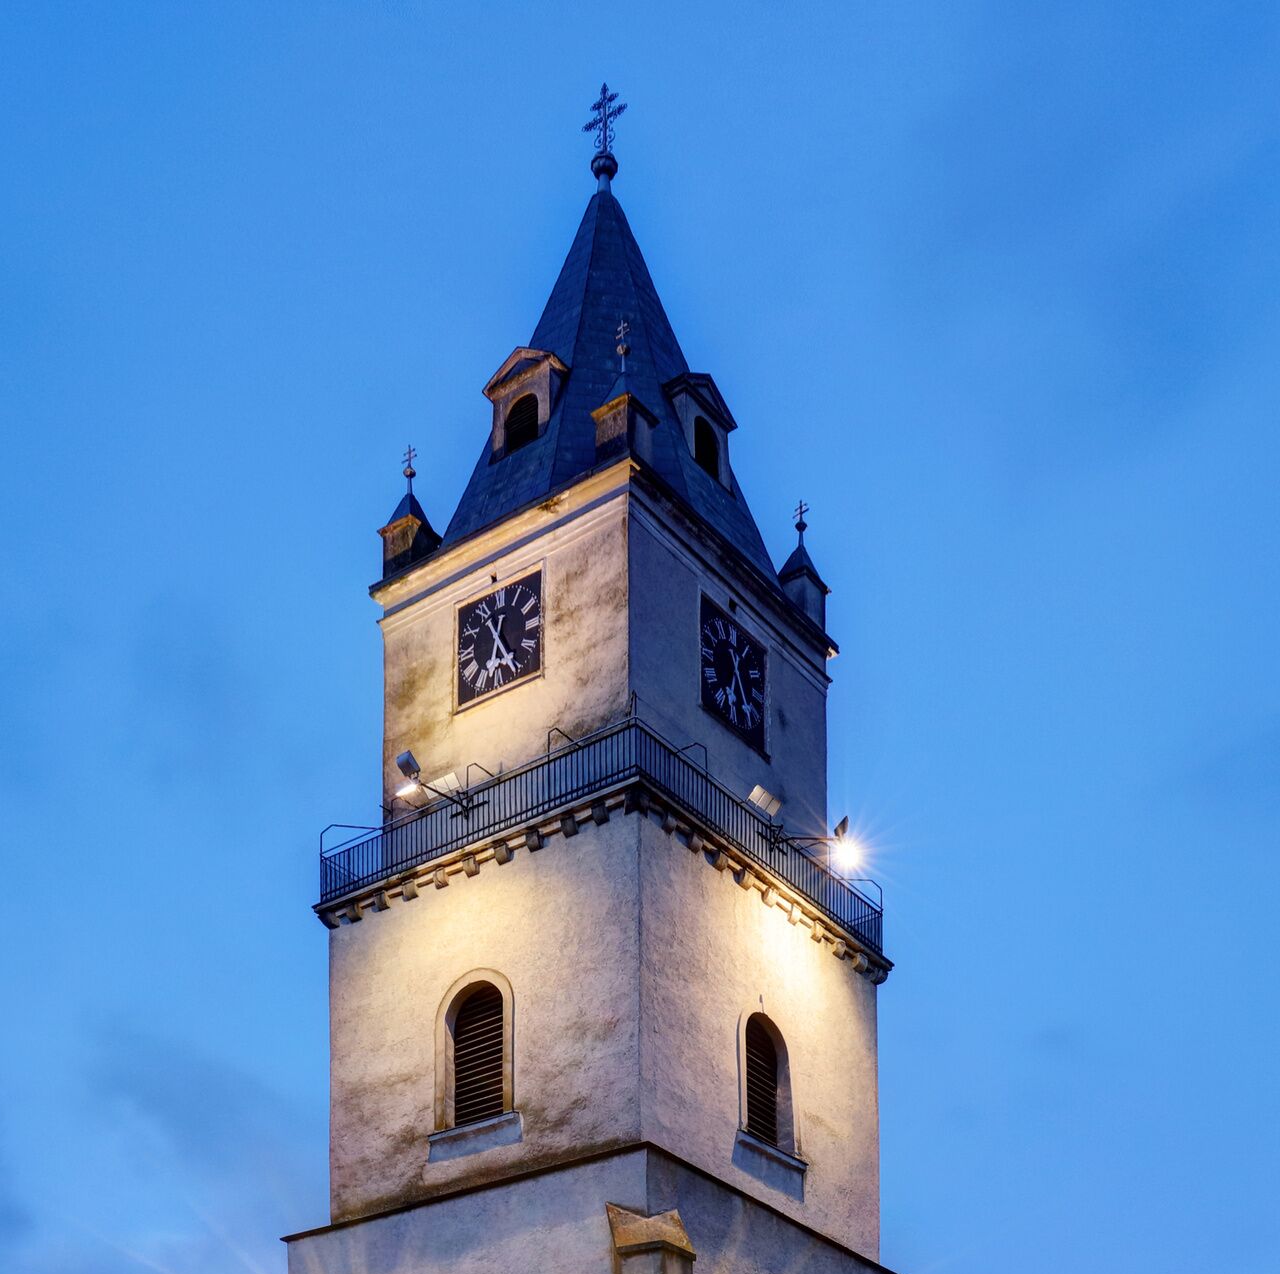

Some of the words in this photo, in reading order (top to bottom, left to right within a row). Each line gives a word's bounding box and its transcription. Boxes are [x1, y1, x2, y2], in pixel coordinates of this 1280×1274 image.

[494, 589, 505, 610] XII
[511, 588, 521, 606] I
[521, 597, 536, 615] II
[475, 601, 491, 623] XI
[464, 623, 480, 638] X
[525, 616, 540, 630] III
[461, 643, 474, 662] IX
[742, 645, 750, 658] I
[463, 659, 479, 681] VIII
[475, 669, 488, 688] VII
